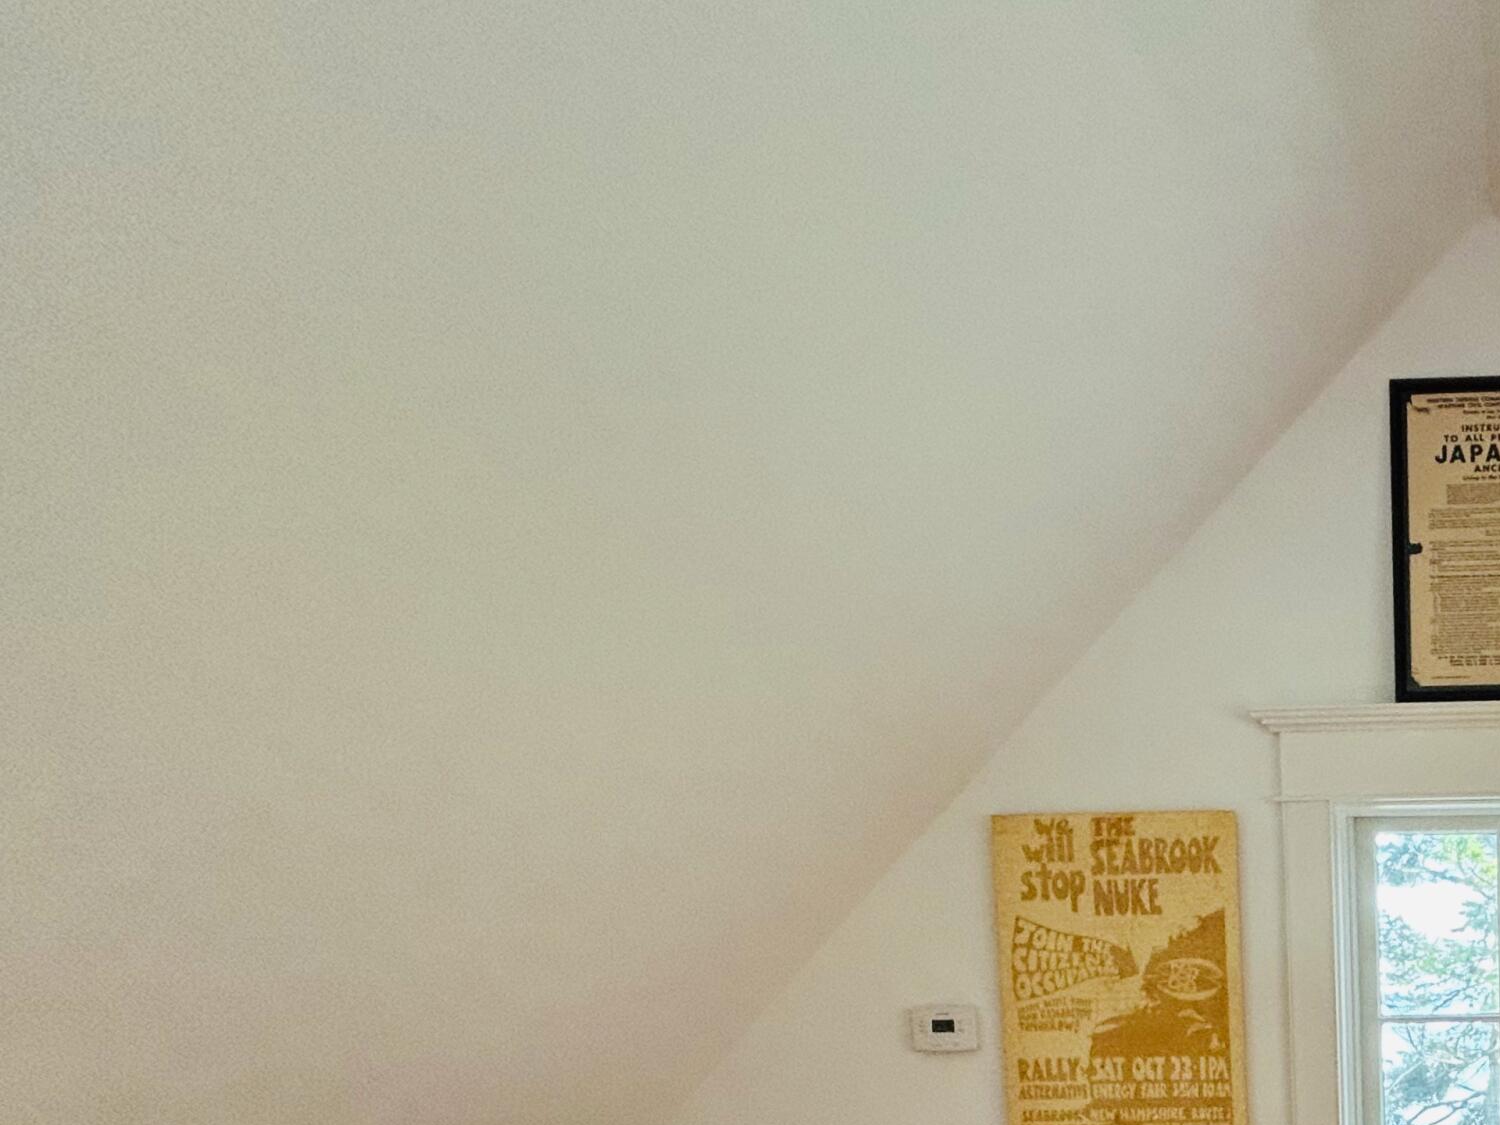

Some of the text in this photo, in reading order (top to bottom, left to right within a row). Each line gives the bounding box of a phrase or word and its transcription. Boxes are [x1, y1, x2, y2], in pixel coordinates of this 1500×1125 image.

[1444, 434, 1458, 442] TO
[1465, 433, 1484, 442] ALL
[1090, 817, 1135, 837] THE
[1022, 831, 1074, 864] will
[1090, 836, 1222, 876] SEABROOK
[1020, 863, 1085, 912] stop
[1093, 878, 1162, 916] NUKE
[1015, 921, 1111, 954] JOIN THE
[1018, 1058, 1080, 1081] RALLY
[1091, 1057, 1126, 1081] SAT
[1132, 1056, 1165, 1080] OCT
[1091, 1083, 1136, 1099] ENERGY
[1141, 1083, 1167, 1097] FAIR
[1090, 1108, 1117, 1121] NEW
[1119, 1107, 1186, 1121] HAMPSHIRE
[1192, 1107, 1224, 1119] ROUTE
